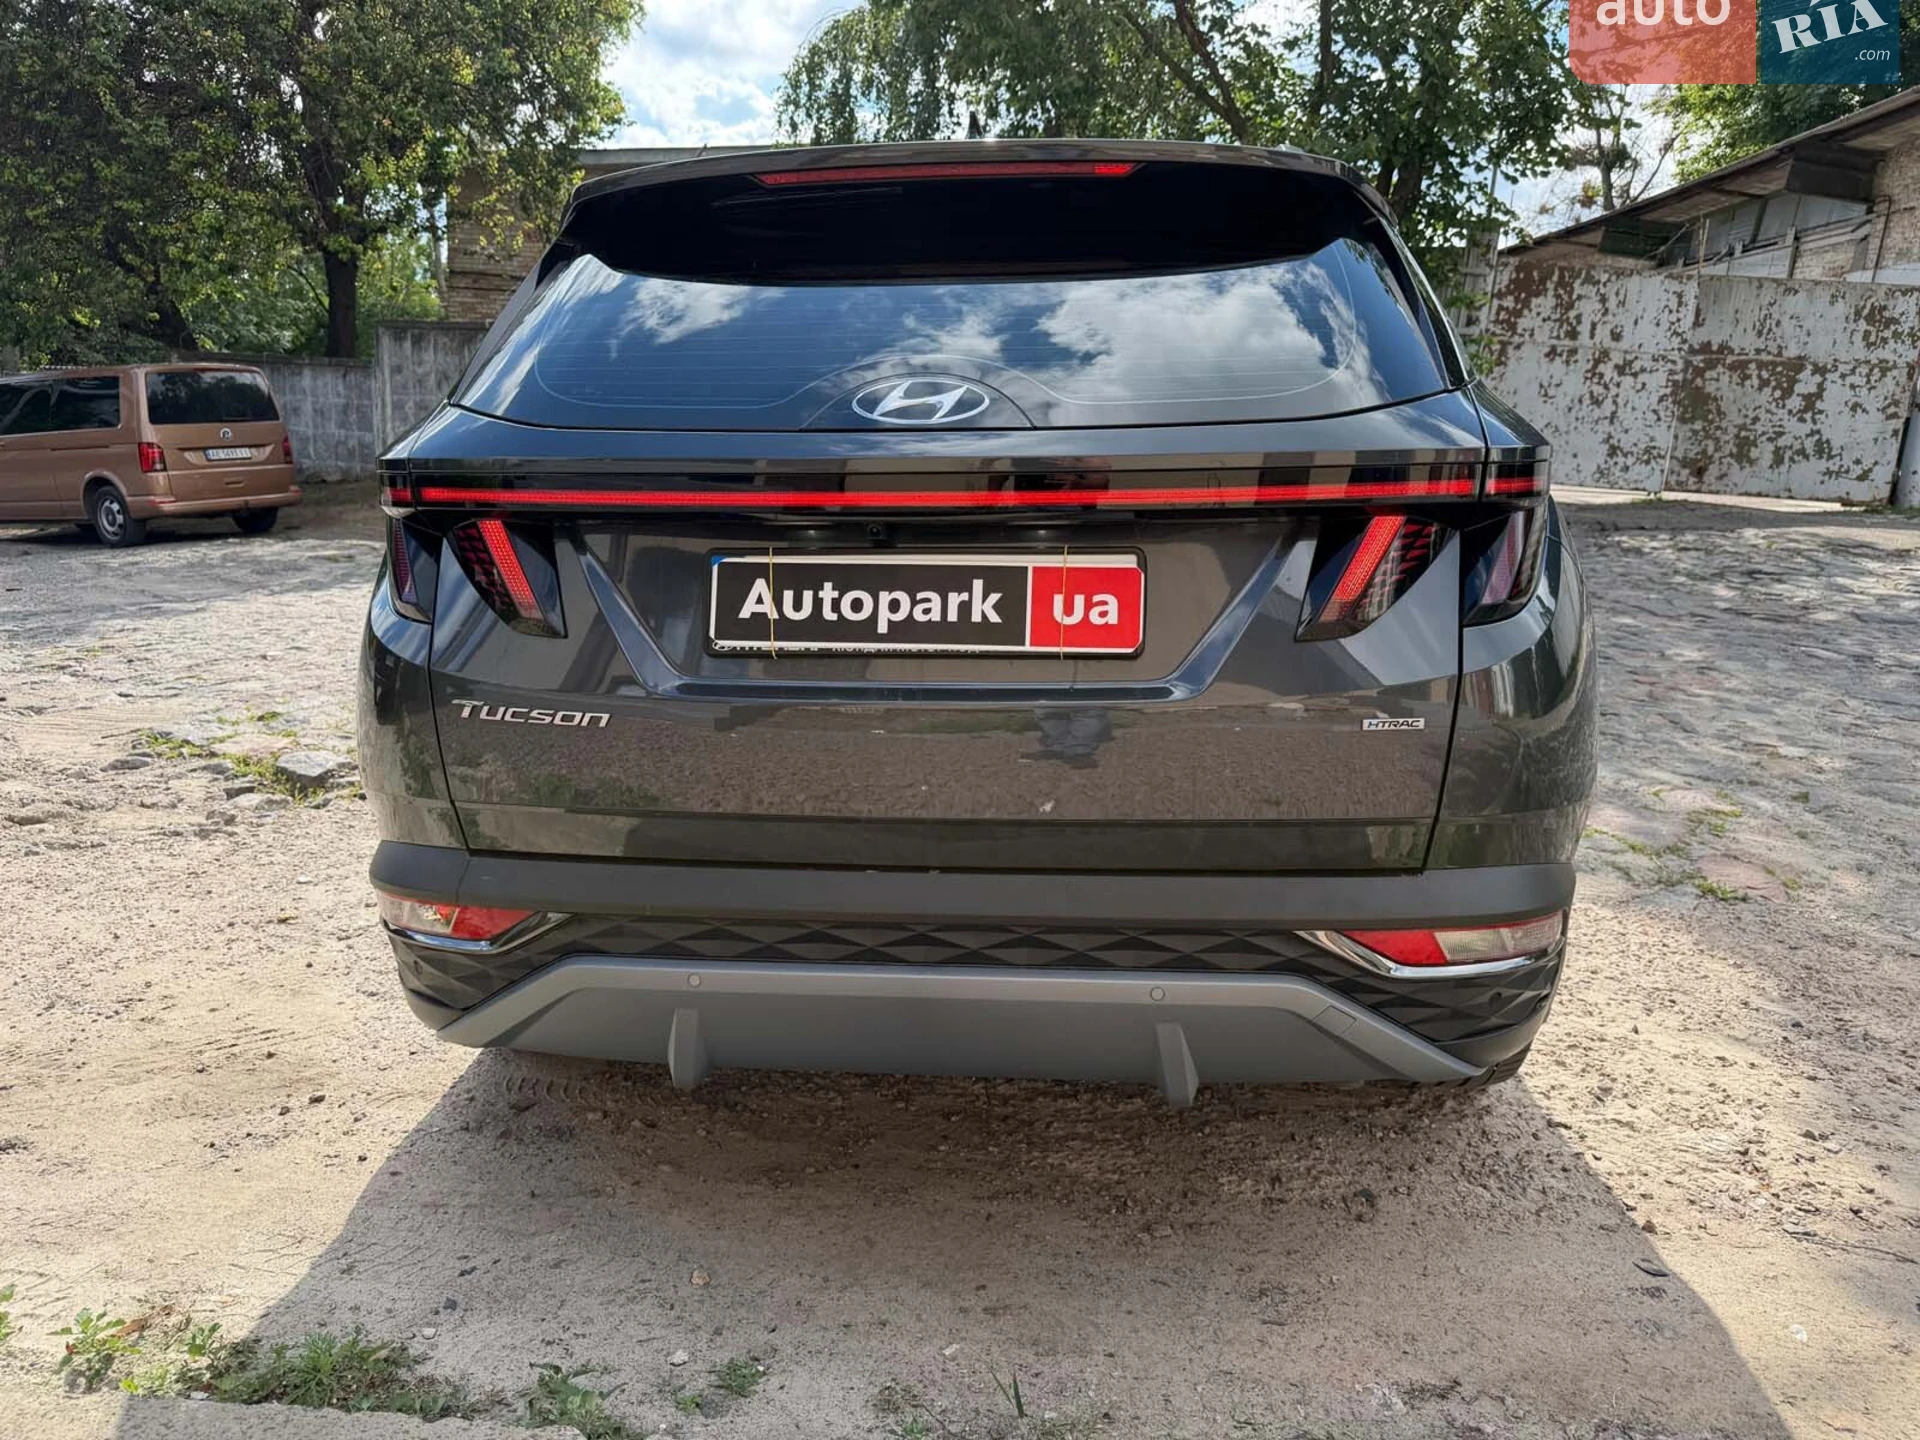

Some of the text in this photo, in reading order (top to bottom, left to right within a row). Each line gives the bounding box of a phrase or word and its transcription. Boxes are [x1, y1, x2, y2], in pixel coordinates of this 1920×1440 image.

[738, 578, 1120, 634] Autopark ua
[1367, 719, 1421, 729] HTRAC
